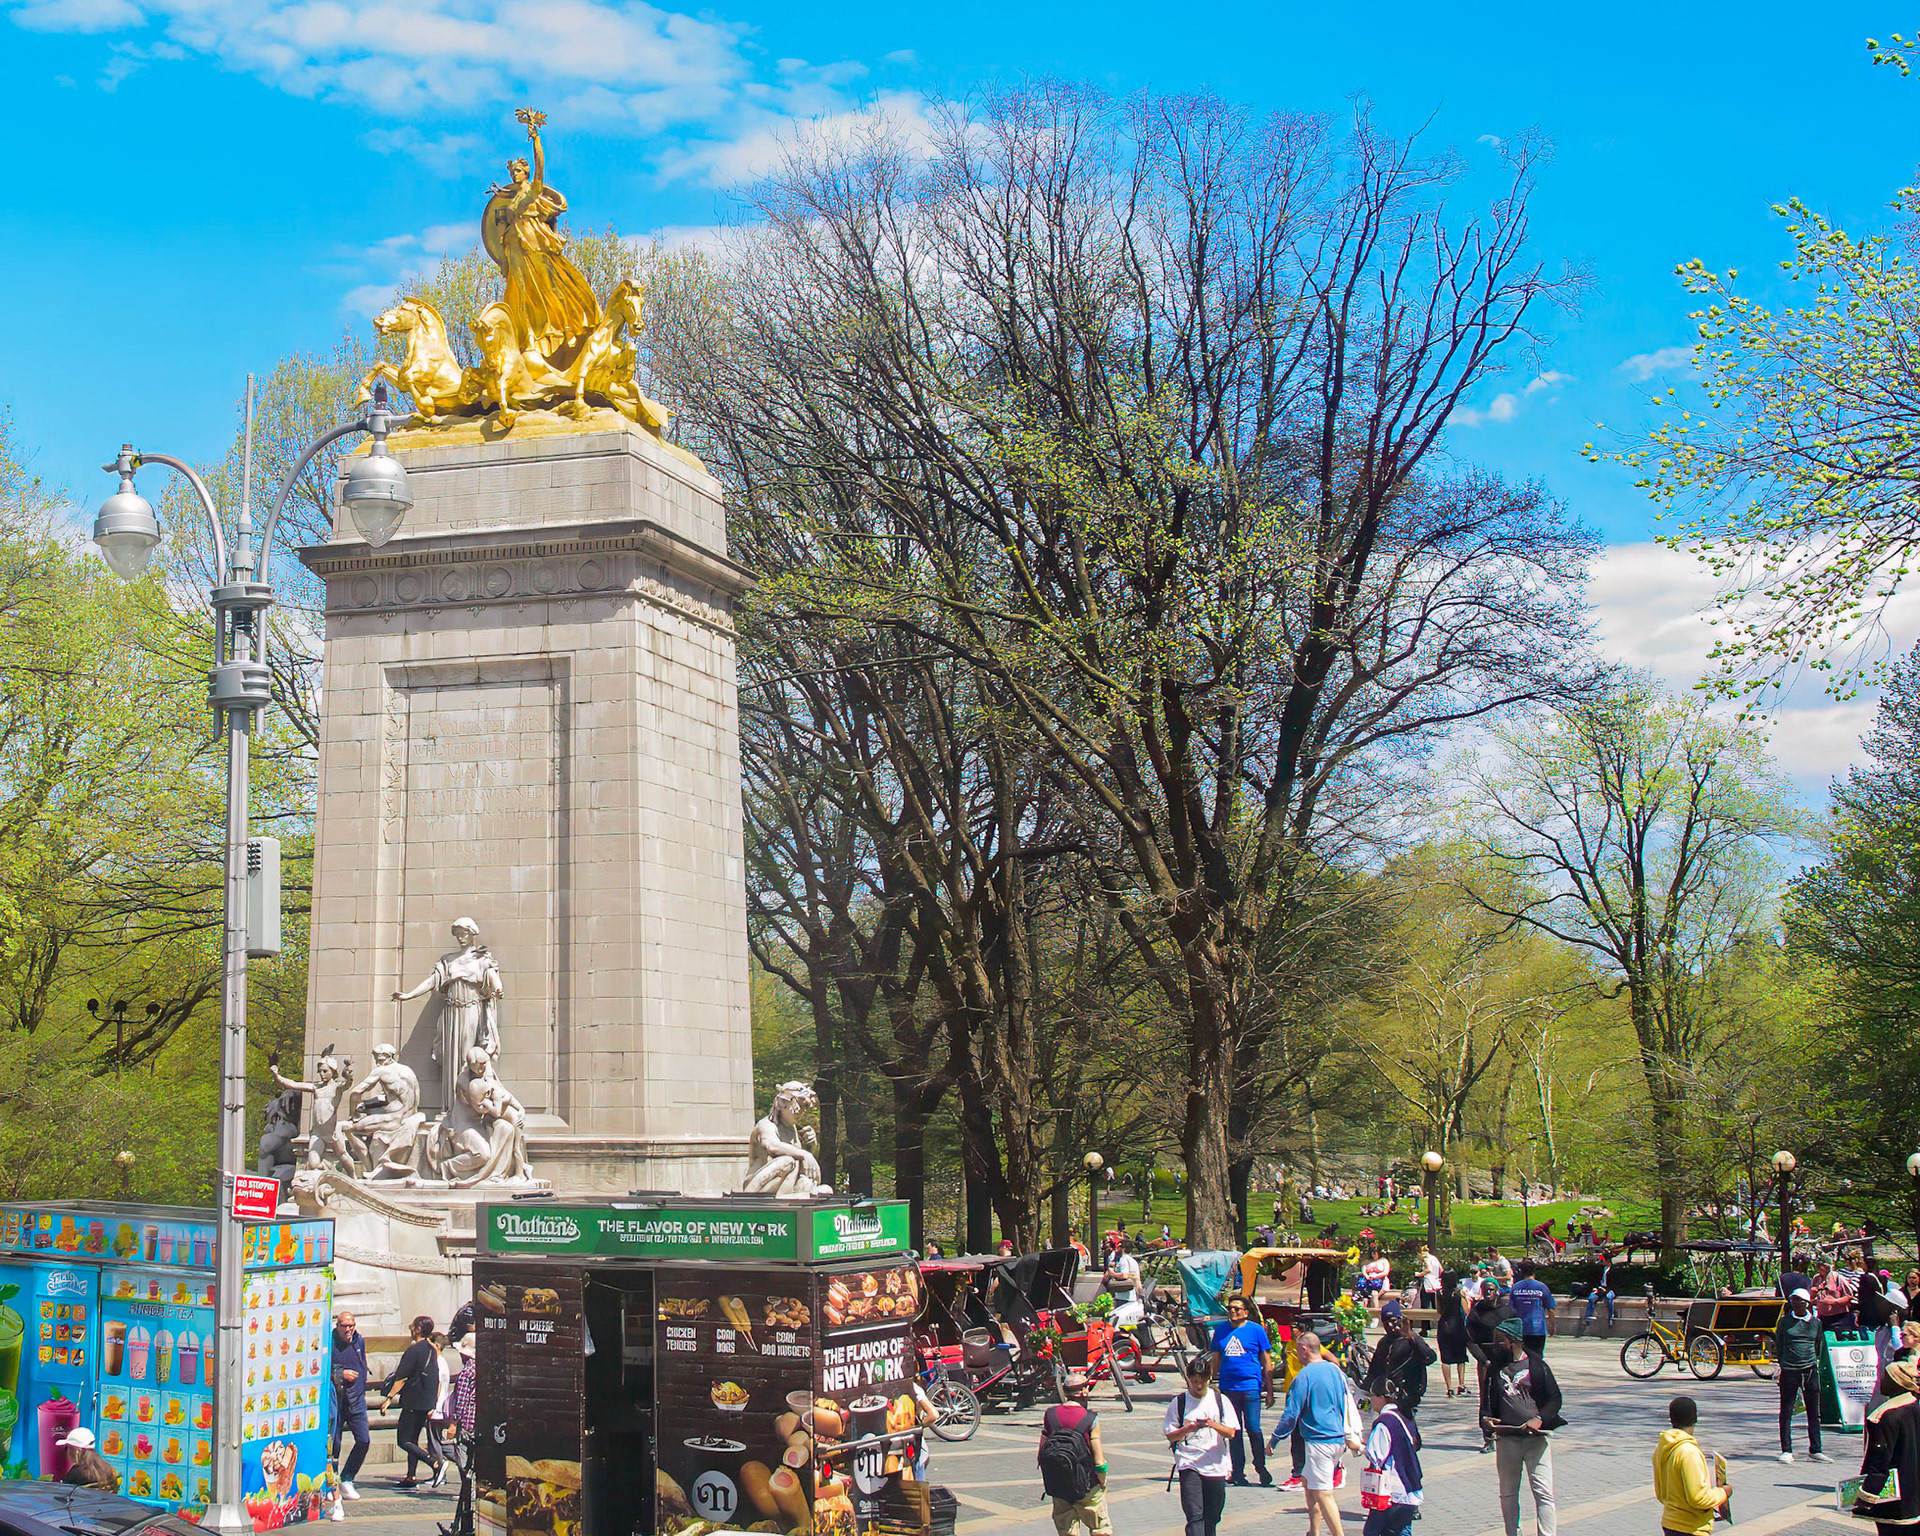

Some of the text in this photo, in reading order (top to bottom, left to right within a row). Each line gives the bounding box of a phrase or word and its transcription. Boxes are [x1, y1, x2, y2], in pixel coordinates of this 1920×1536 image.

[598, 1219, 788, 1236] THE FLAVOR OF NEW YORK
[176, 1308, 195, 1320] TEA
[823, 1337, 905, 1366] THE FLAVOR OF
[823, 1356, 905, 1393] NEW YORK
